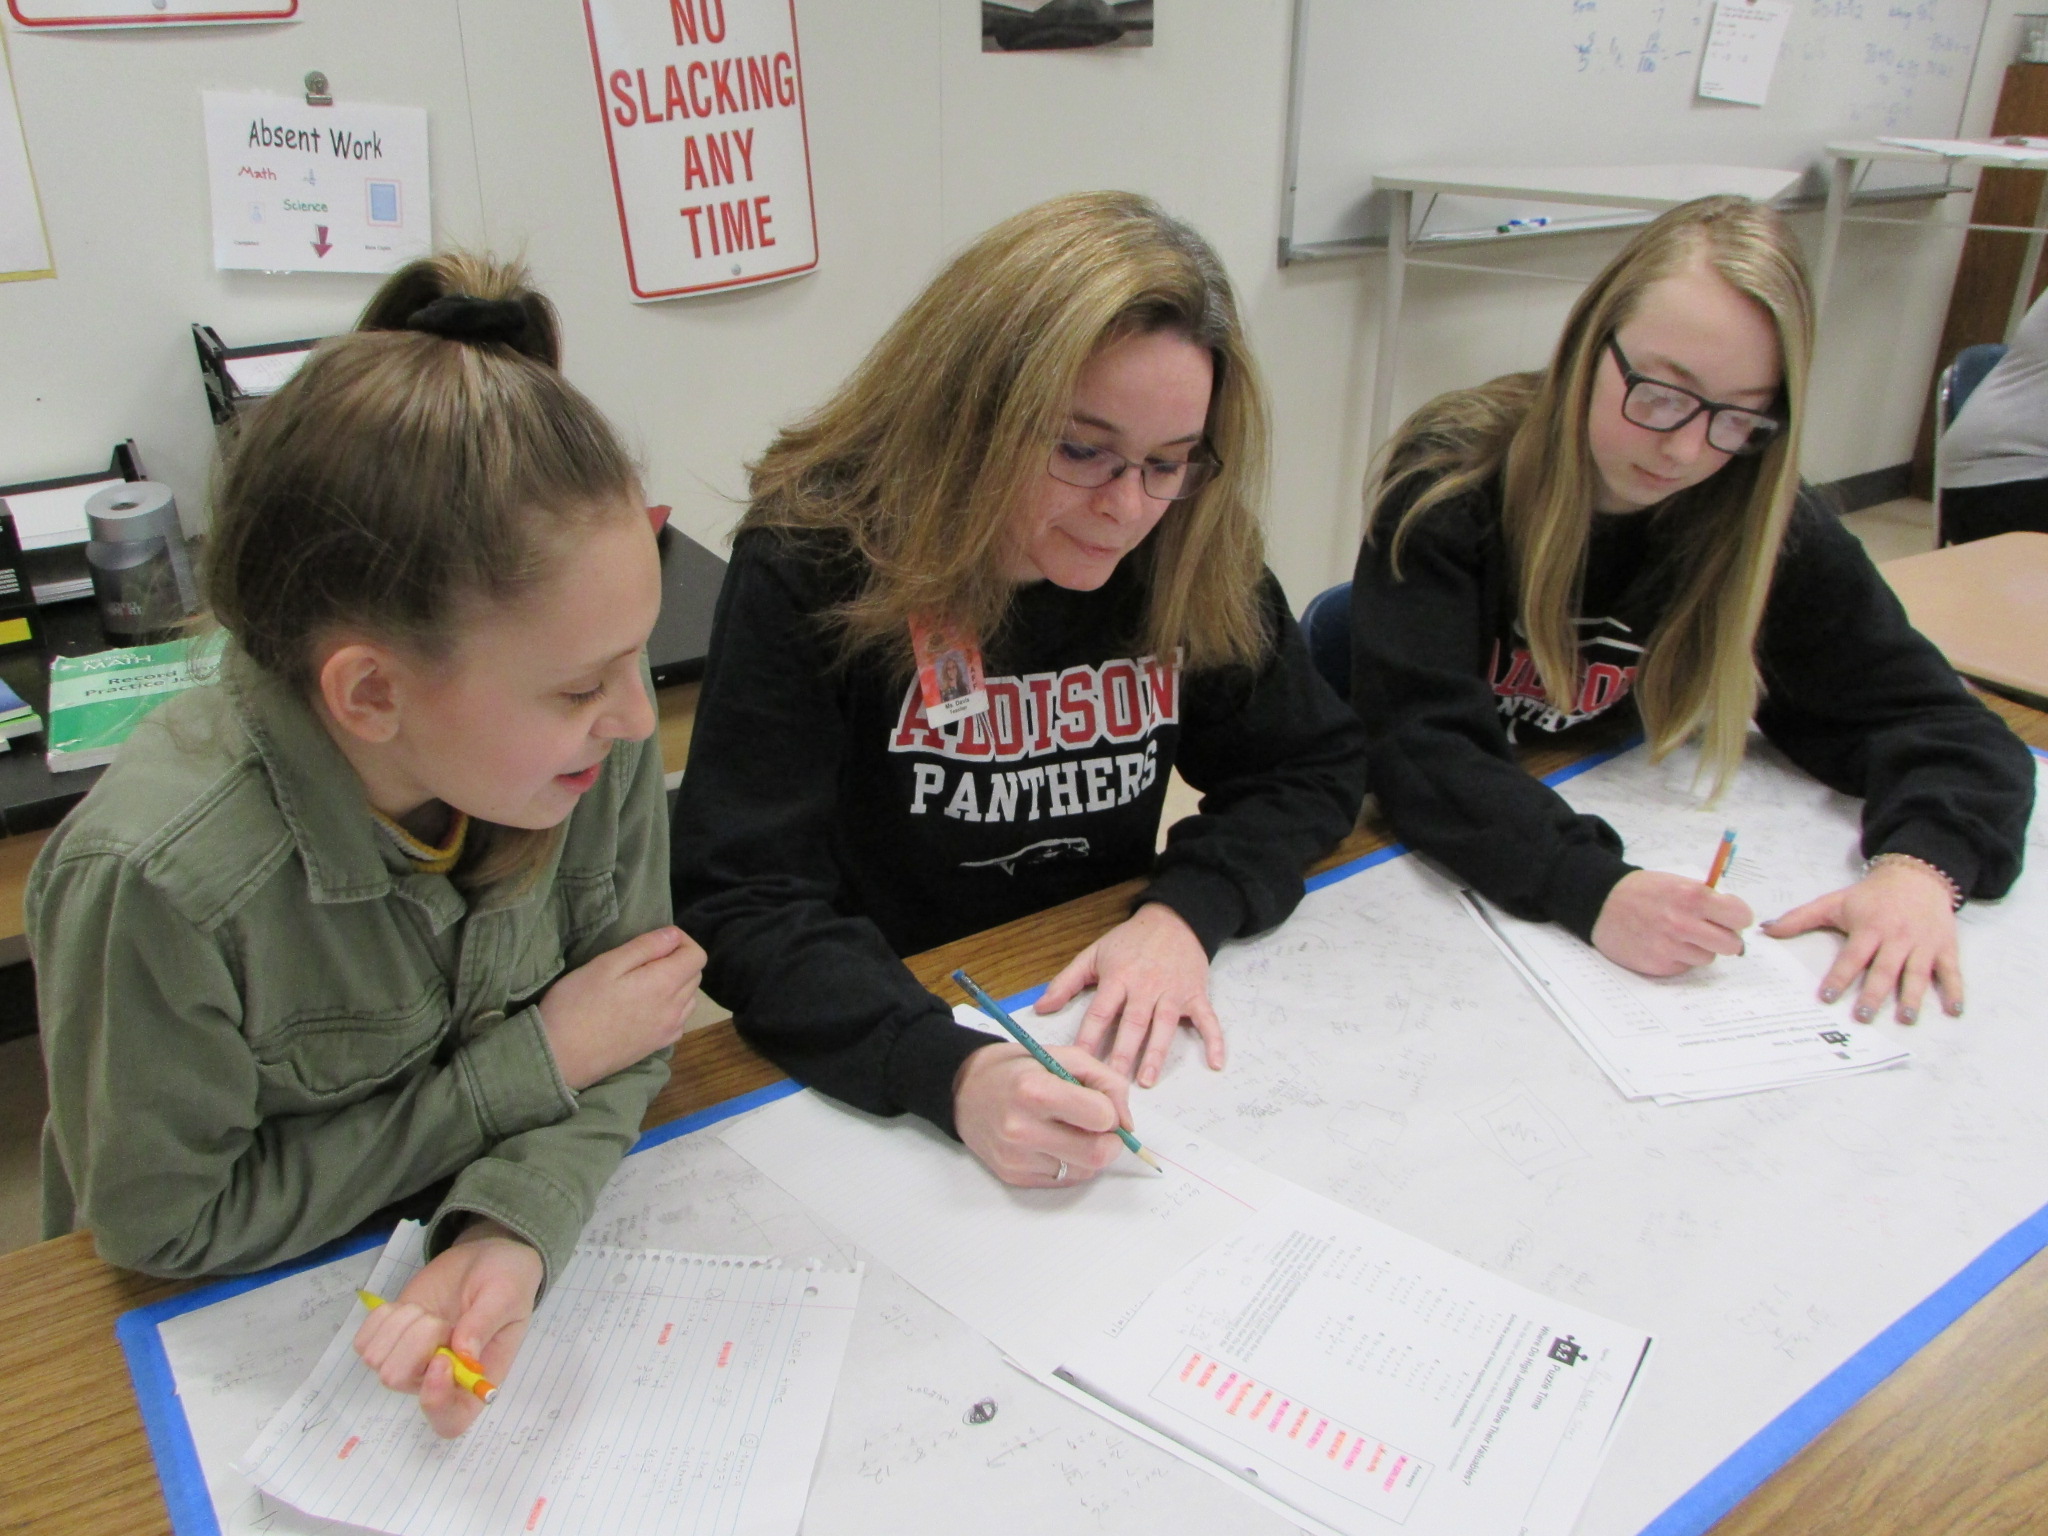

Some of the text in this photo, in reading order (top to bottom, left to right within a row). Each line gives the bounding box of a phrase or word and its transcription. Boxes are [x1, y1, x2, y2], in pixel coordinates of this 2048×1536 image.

[670, 0, 726, 46] NO
[609, 51, 796, 127] SLACKING
[249, 118, 383, 161] Absent Work
[238, 165, 278, 181] Math
[684, 127, 755, 191] ANY
[283, 199, 329, 213] Science
[680, 195, 776, 259] TIME
[84, 655, 151, 672] MATH
[108, 670, 177, 685] Record
[85, 681, 165, 697] Practice
[910, 739, 1157, 823] PANTHERS
[1539, 1362, 1561, 1391] Puzzle
[1529, 1389, 1548, 1411] Time
